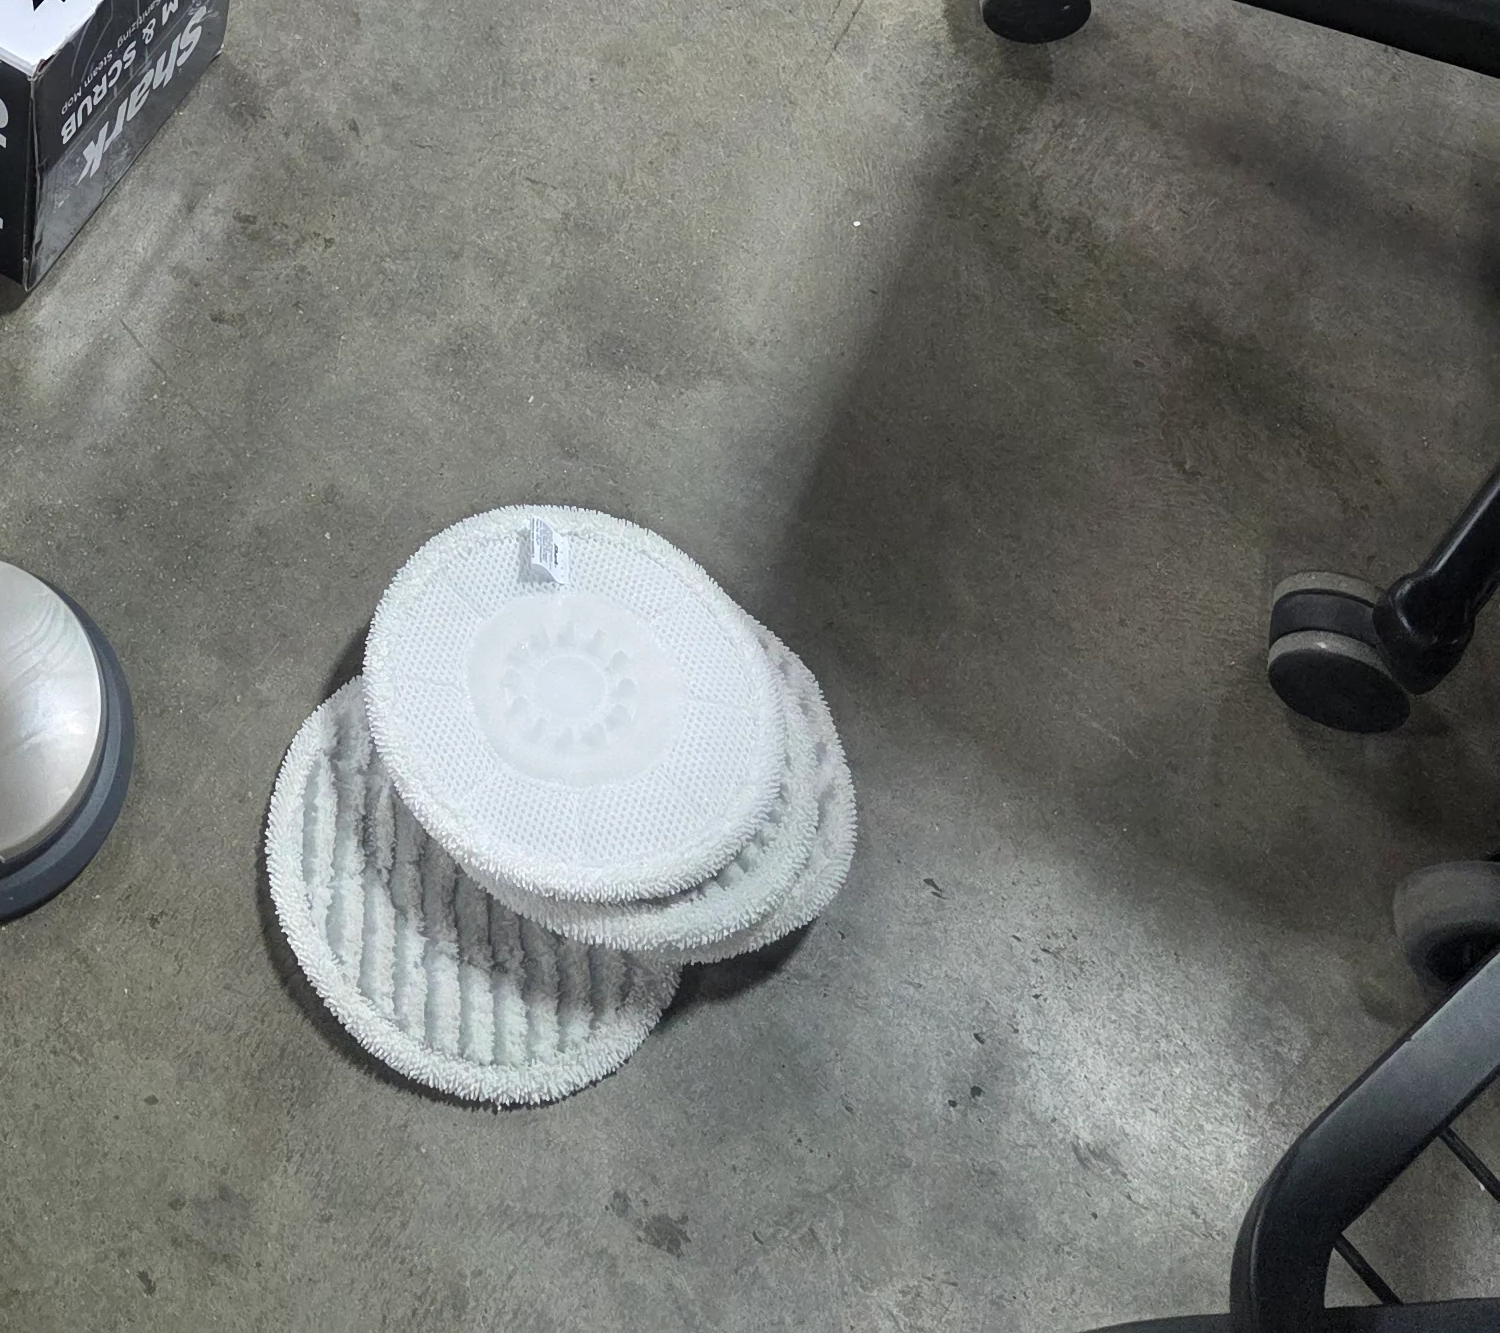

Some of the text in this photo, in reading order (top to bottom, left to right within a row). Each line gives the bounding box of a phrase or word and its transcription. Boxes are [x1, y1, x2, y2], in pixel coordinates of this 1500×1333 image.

[142, 17, 156, 45] &
[84, 48, 113, 82] Steam
[60, 40, 137, 145] SCRUB
[61, 86, 83, 115] Mop
[76, 5, 208, 184] Shark
